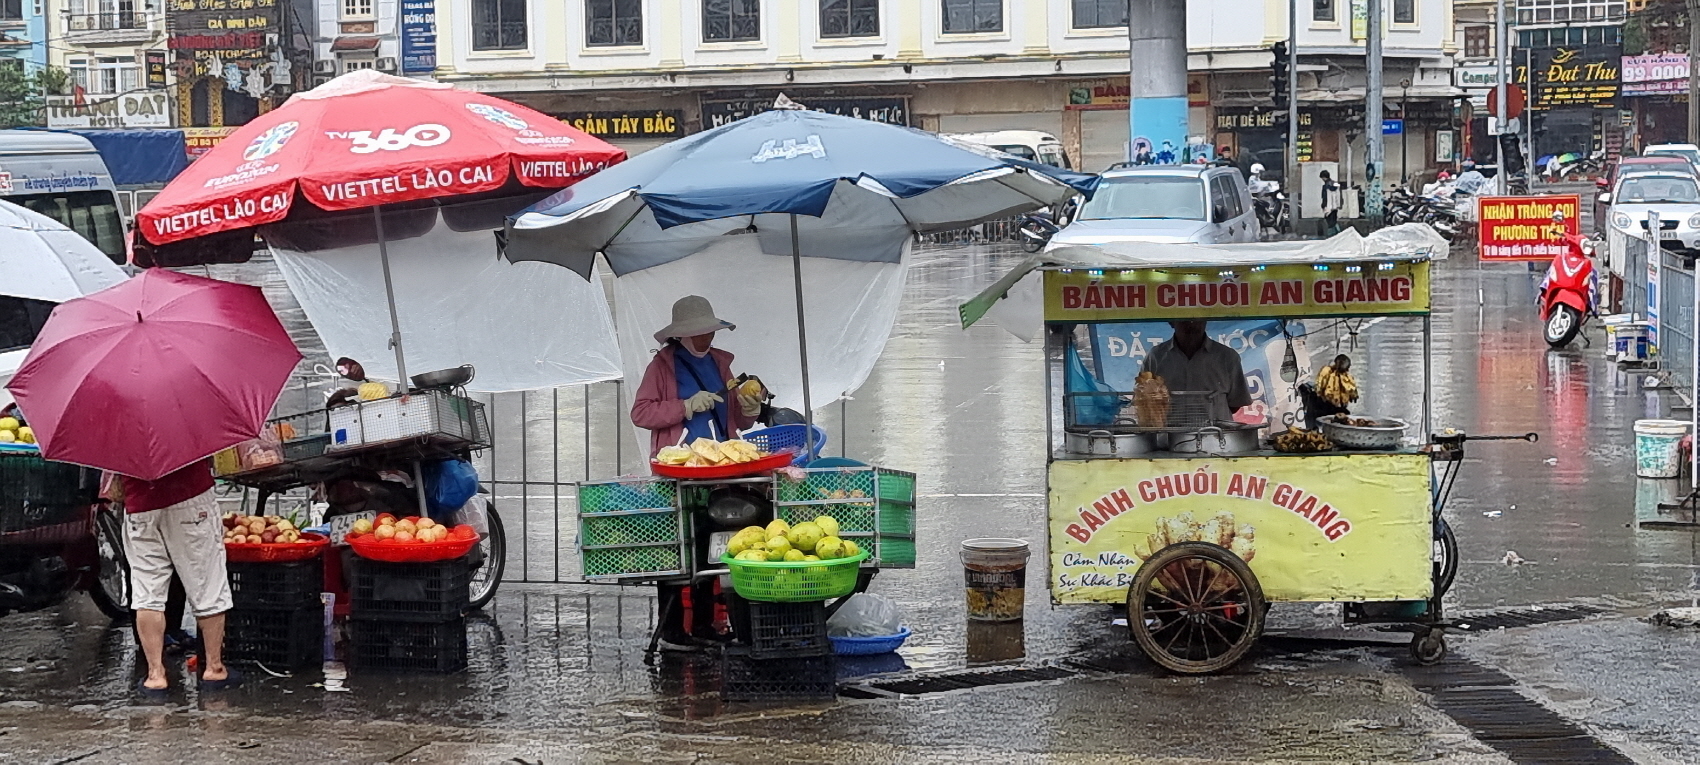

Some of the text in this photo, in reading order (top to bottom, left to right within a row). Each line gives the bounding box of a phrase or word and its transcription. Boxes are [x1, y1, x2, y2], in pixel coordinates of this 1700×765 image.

[1461, 70, 1510, 85] Compur
[1546, 64, 1579, 84] Đạt
[1584, 60, 1618, 81] Thu
[124, 94, 166, 119] ĐẠT
[89, 116, 127, 127] HOTEL
[574, 112, 608, 134] SẢN
[612, 115, 640, 134] TÂY
[643, 110, 676, 133] BẮC
[520, 161, 571, 178] VIETTEL
[322, 165, 493, 201] VIETTEL LÀO CAI
[154, 192, 288, 235] VIETTEL LÀO CAI
[1483, 202, 1515, 223] NHẬN
[1517, 201, 1554, 219] TRÔNG
[1493, 224, 1538, 241] PHƯƠNG
[1062, 274, 1411, 310] BÁNH CHUỐI AN GIANG
[1064, 464, 1351, 544] BÁNH CHUỐI AN GIANG
[1099, 553, 1136, 570] Nhận
[1081, 573, 1114, 588] Khác
[1116, 574, 1133, 587] Bi
